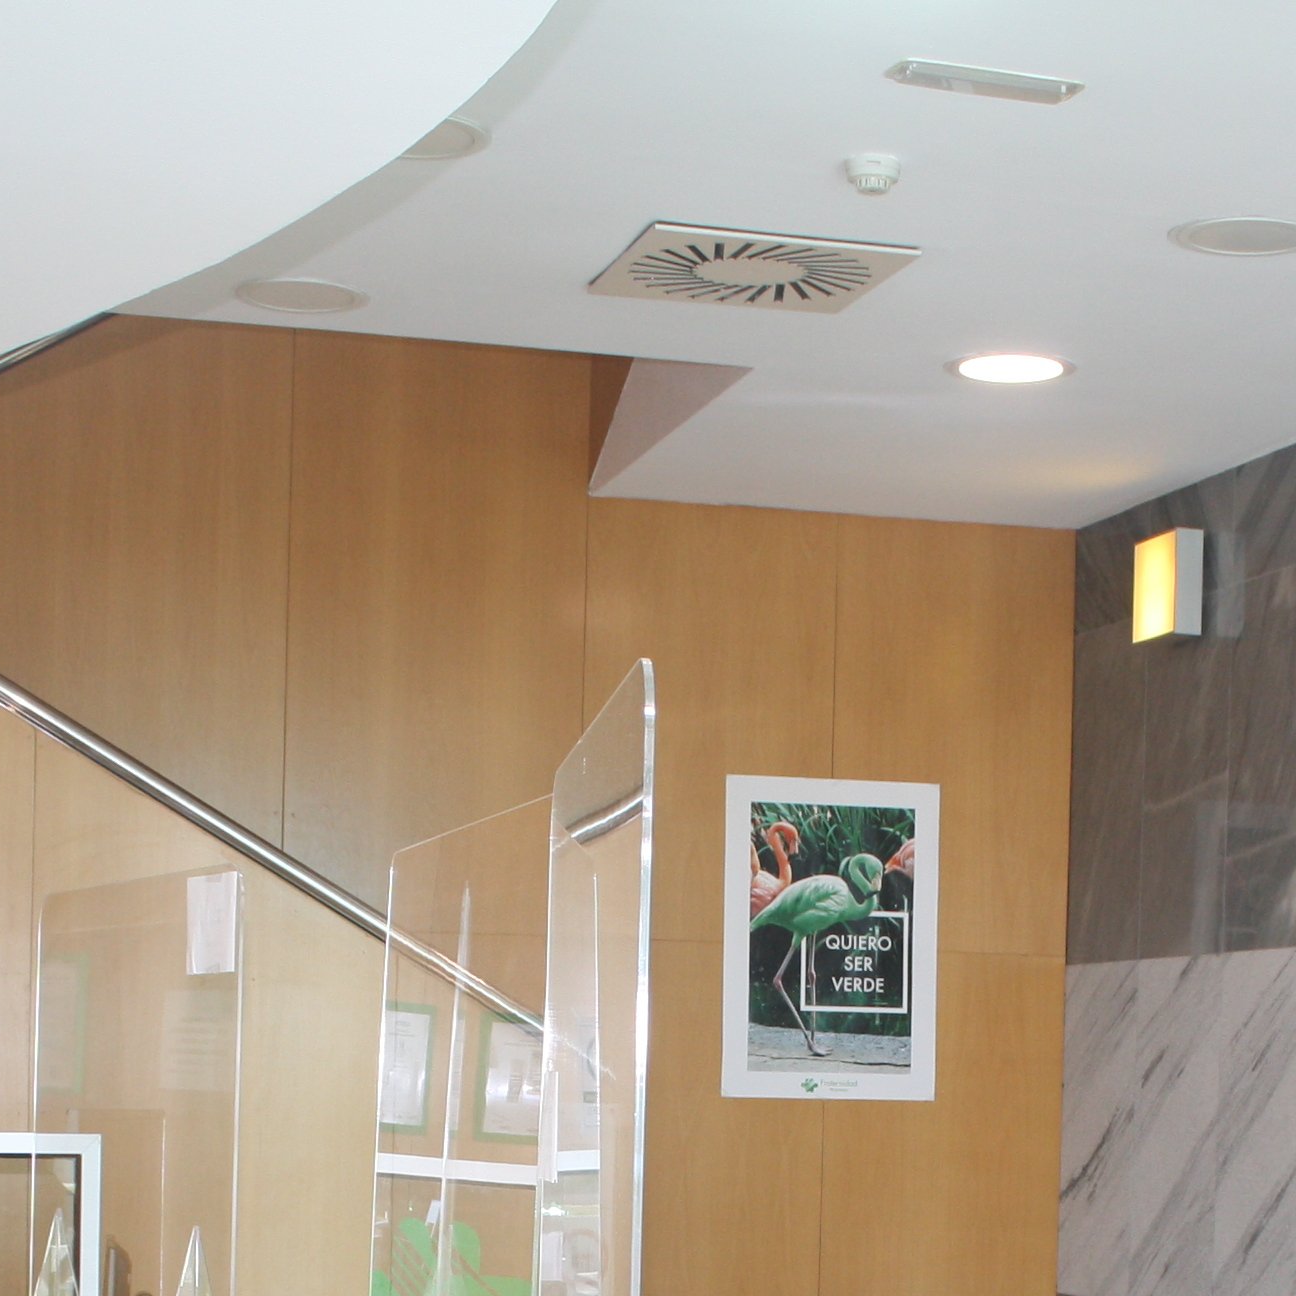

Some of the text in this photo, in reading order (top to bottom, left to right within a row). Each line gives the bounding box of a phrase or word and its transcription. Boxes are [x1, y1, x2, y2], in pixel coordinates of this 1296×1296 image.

[825, 933, 892, 952] QUIERO
[843, 955, 873, 972] SER
[831, 976, 885, 993] VERDE
